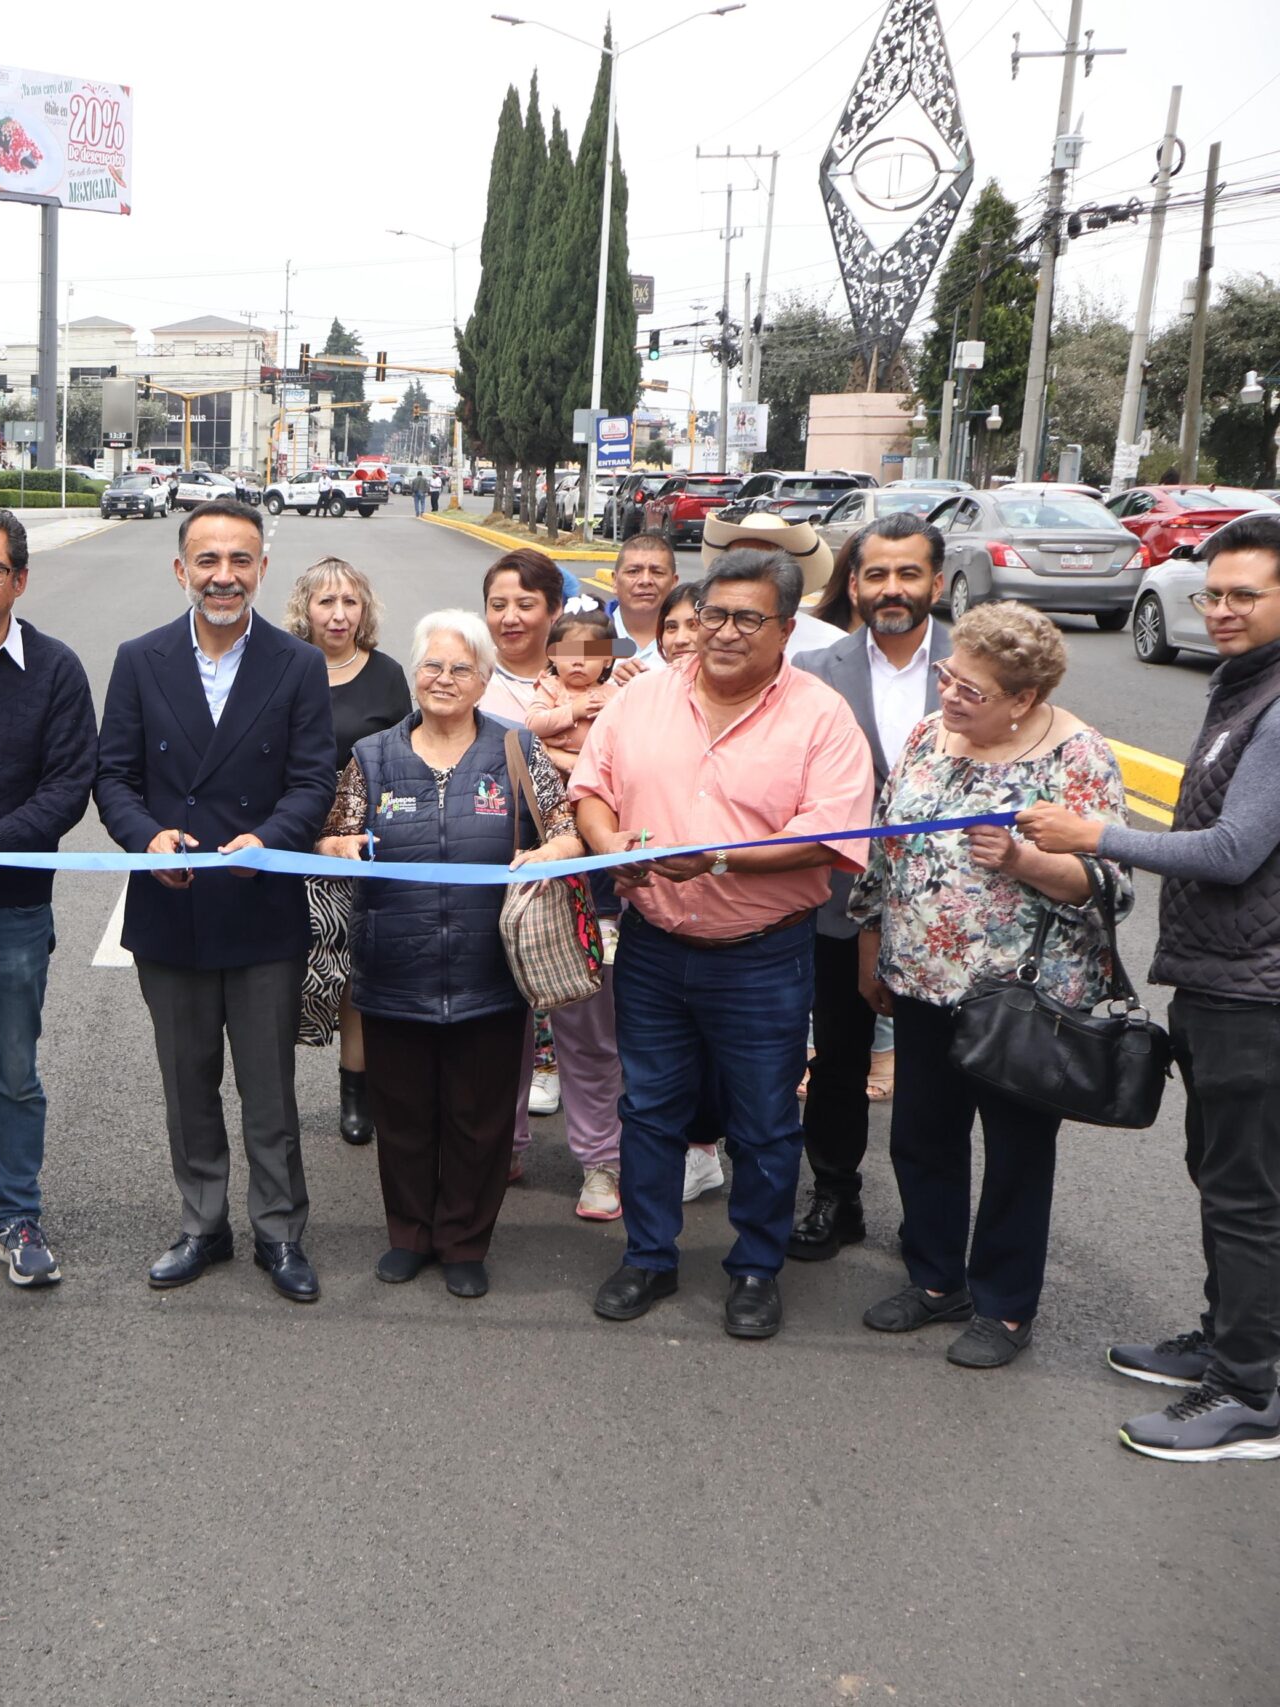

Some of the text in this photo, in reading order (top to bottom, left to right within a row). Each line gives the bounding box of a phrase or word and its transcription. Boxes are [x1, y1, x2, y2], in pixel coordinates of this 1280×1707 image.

[69, 95, 125, 149] 20%
[68, 144, 126, 167] De descuento
[68, 178, 117, 203] MEXICANA
[474, 795, 506, 809] DIF
